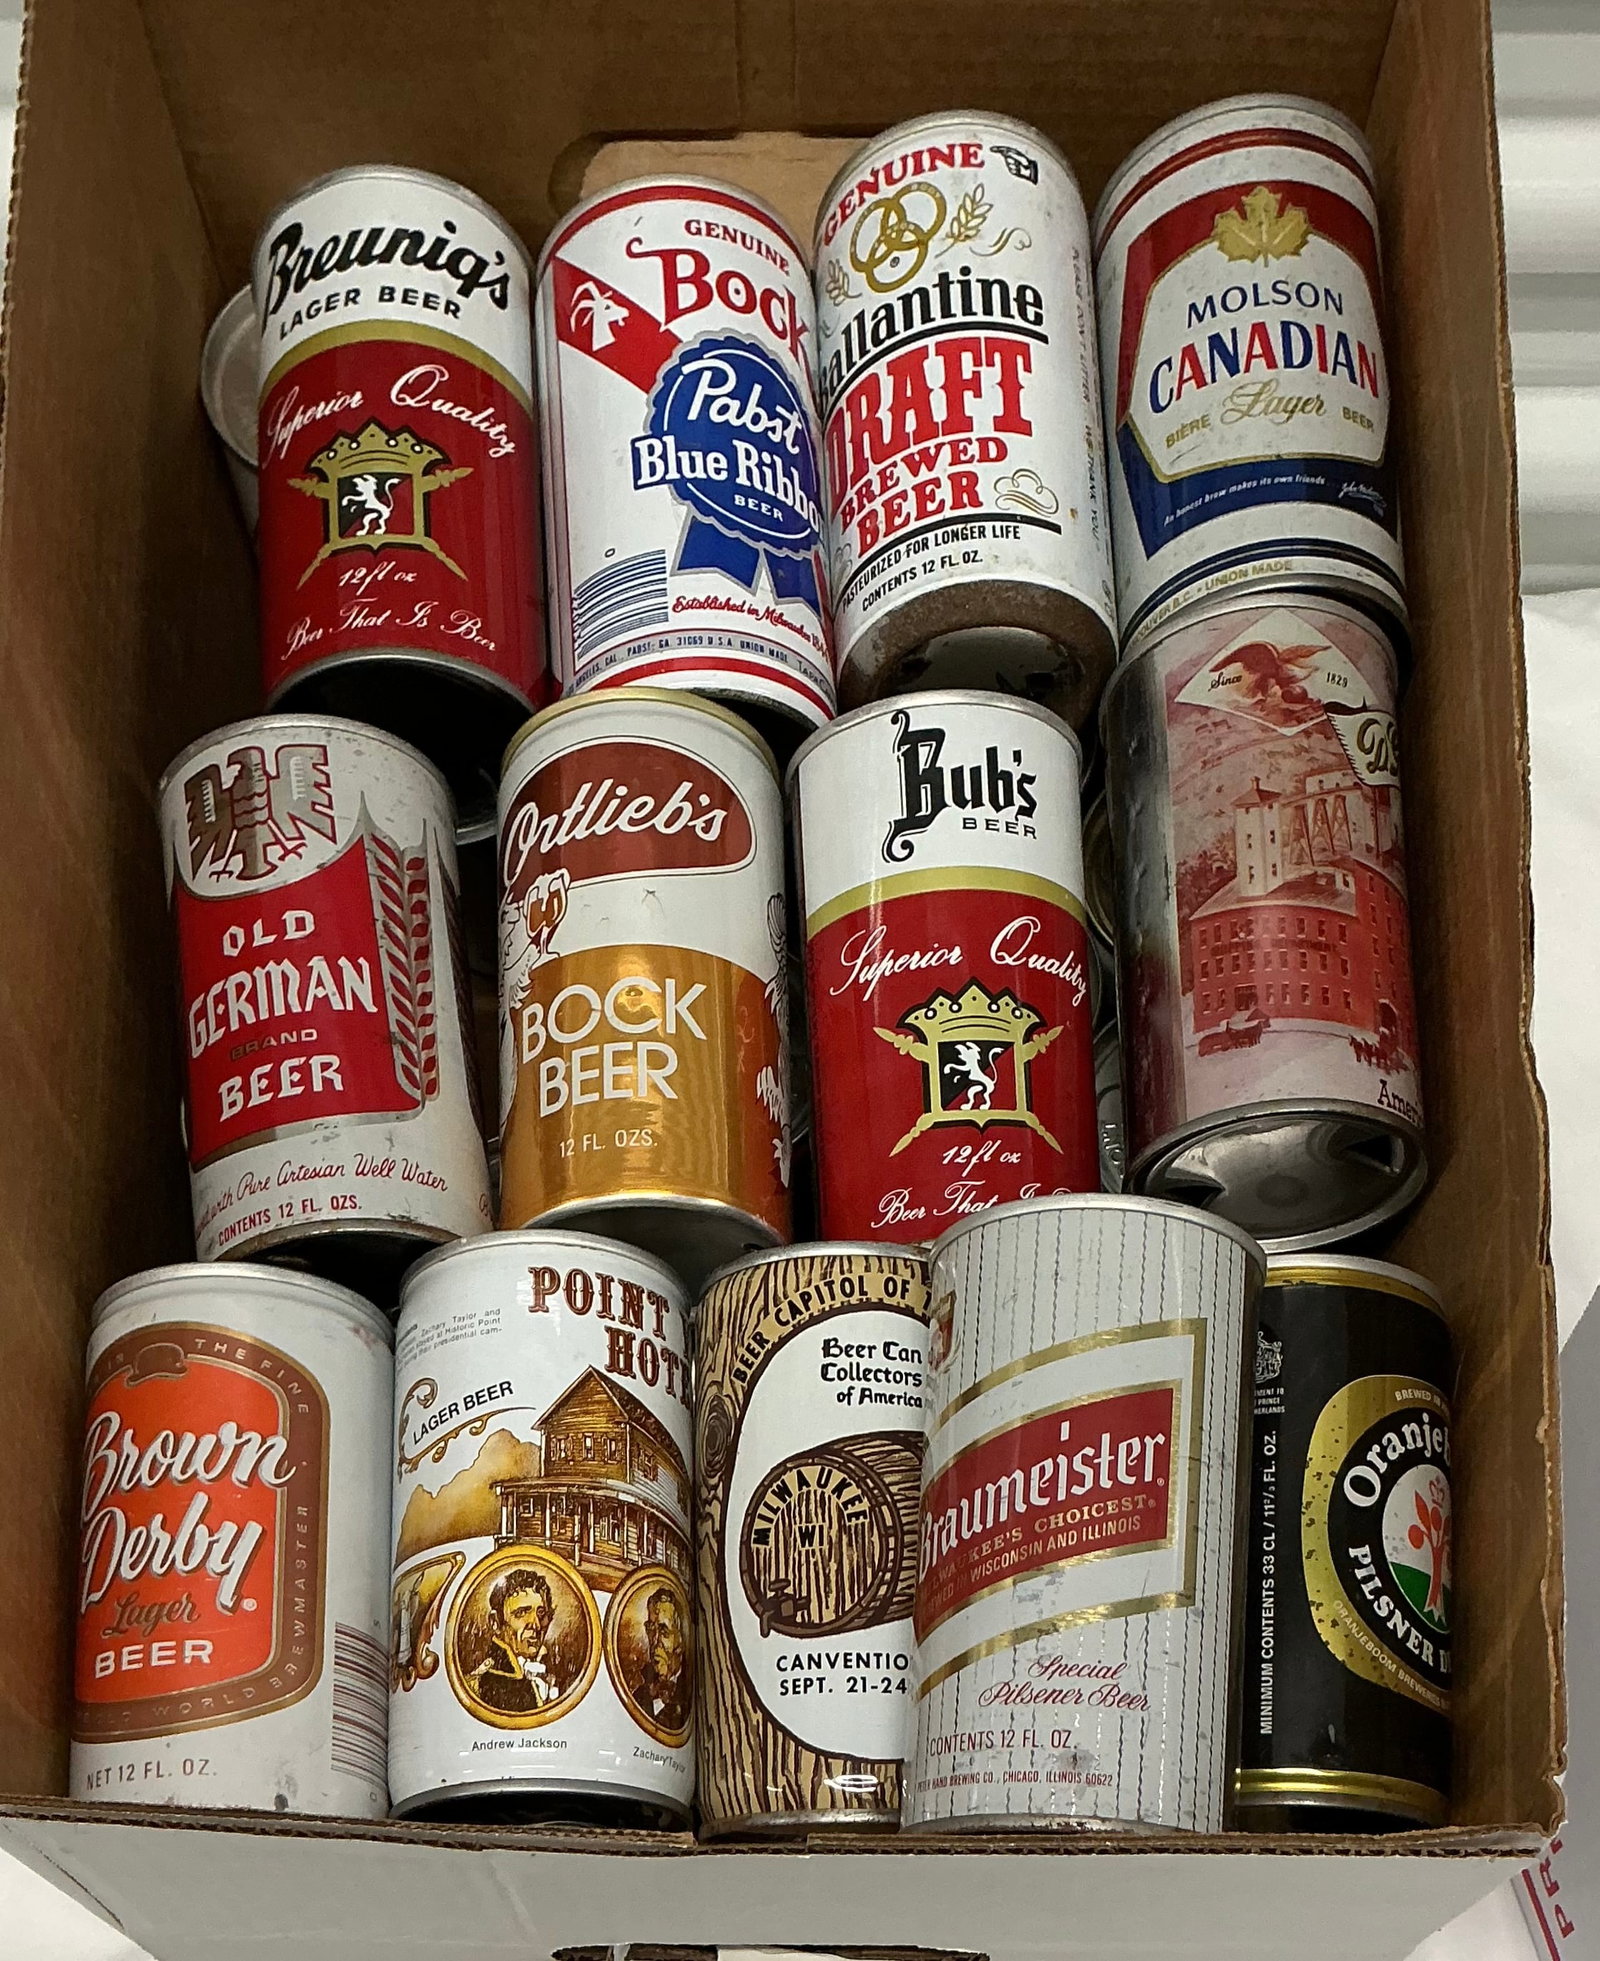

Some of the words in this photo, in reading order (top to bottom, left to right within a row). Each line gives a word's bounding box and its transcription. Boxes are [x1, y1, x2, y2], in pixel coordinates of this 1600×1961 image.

[823, 143, 985, 247] GENUINE
[684, 218, 789, 277] GENUINE
[262, 220, 511, 338] Breunig's
[1186, 280, 1344, 328] MOLSON
[279, 286, 360, 340] LAGER
[379, 286, 461, 320] BEER
[625, 237, 818, 385] BOCK
[1149, 320, 1379, 414] CANADIAN
[262, 385, 364, 468] Superior
[390, 364, 516, 459] Quality
[682, 359, 801, 454] Pabst
[824, 336, 1032, 522] DRAFT
[1220, 378, 1327, 425] Lager
[1342, 406, 1374, 433] BEER
[637, 435, 728, 487] Blue
[841, 437, 1008, 535] BREWED
[735, 495, 783, 522] BEER
[1229, 480, 1258, 493] makes
[857, 470, 984, 559] BEER
[842, 549, 902, 613] PASTEURIZED
[906, 536, 930, 559] FOR
[934, 524, 987, 548] LONGER
[992, 525, 1020, 541] LIFE
[862, 570, 917, 612] CONTENTS
[922, 563, 936, 575] 12
[962, 550, 984, 564] OZ.
[1205, 569, 1249, 591] UNION
[1252, 561, 1293, 577] MADE
[281, 616, 324, 660] Beer
[330, 597, 391, 633] That
[396, 600, 438, 628] Is
[440, 609, 497, 651] Beer
[672, 595, 746, 613] Established
[747, 604, 760, 616] in
[740, 640, 764, 653] UNION
[1208, 672, 1242, 691] Since
[1326, 672, 1348, 688] 1829
[882, 710, 1038, 864] Bub's
[504, 778, 727, 887] Ortlieb's
[961, 817, 1038, 839] BEER
[223, 909, 315, 958] OLD
[830, 925, 964, 1001] Superior
[989, 916, 1087, 1006] Quality
[188, 955, 378, 1059] GERMAN
[522, 976, 707, 1064] BOCK
[229, 1028, 318, 1060] BRAND
[218, 1054, 344, 1123] BEER
[539, 1041, 679, 1118] BEER
[559, 1138, 575, 1158] 12
[582, 1134, 606, 1153] FL.
[615, 1129, 658, 1149] OZS.
[237, 1171, 271, 1200] Pure
[277, 1160, 345, 1187] Artesian
[353, 1153, 396, 1179] Well
[401, 1158, 448, 1191] Water
[218, 1208, 271, 1246] CONTENTS
[278, 1203, 294, 1219] 12
[301, 1198, 323, 1215] FL.
[330, 1194, 362, 1211] OZS.
[871, 1187, 926, 1229] Beer
[933, 1180, 999, 1216] That
[478, 1317, 501, 1326] Point
[484, 1308, 501, 1317] and
[528, 1266, 669, 1341] POINT
[195, 1338, 246, 1361] THE
[732, 1330, 771, 1385] BEER
[774, 1275, 868, 1328] CAPITOL
[884, 1276, 910, 1300] OF
[821, 1337, 877, 1359] Beer
[882, 1341, 923, 1364] Can
[820, 1362, 923, 1387] Collectors
[836, 1386, 854, 1406] of
[858, 1387, 923, 1408] America
[1394, 1388, 1432, 1401] BREWED
[413, 1402, 460, 1445] LAGER
[463, 1381, 514, 1411] BEER
[81, 1410, 296, 1520] Brown
[1264, 1430, 1277, 1457] OZ.
[1263, 1461, 1276, 1482] FL.
[752, 1466, 869, 1547] MILWAUKEE
[919, 1420, 1165, 1584] Braumeister
[1034, 1493, 1147, 1533] CHOICEST
[80, 1490, 263, 1616] Derby
[799, 1525, 825, 1547] WI
[970, 1540, 1043, 1582] WISCONSIN
[1046, 1530, 1078, 1552] AND
[1082, 1514, 1141, 1542] ILLINOIS
[1263, 1532, 1275, 1551] CL
[1262, 1555, 1275, 1575] 33
[102, 1592, 200, 1639] Lager
[1261, 1578, 1275, 1659] CONTENTS
[1348, 1544, 1434, 1666] PILSNER
[95, 1639, 214, 1679] BEER
[1333, 1600, 1397, 1673] ORANJEBOOM
[779, 1677, 833, 1696] SEPT.
[1028, 1654, 1129, 1680] Special
[152, 1686, 256, 1717] WORLD
[978, 1681, 1084, 1709] Pilsener
[1087, 1683, 1152, 1712] Beer
[1260, 1663, 1273, 1734] MINIMUM
[472, 1738, 515, 1752] Andrew
[518, 1738, 567, 1748] Jackson
[930, 1730, 994, 1757] CONTENTS
[1000, 1730, 1015, 1748] 12
[1023, 1730, 1044, 1748] FL.
[1051, 1730, 1077, 1749] OZ.
[86, 1767, 112, 1790] NET
[118, 1763, 135, 1782] 12
[144, 1760, 173, 1779] FL.
[183, 1758, 218, 1776] OZ.
[950, 1772, 980, 1786] BREWING
[1003, 1771, 1041, 1785] CHICAGO,
[1046, 1771, 1082, 1784] ILLINOIS
[1085, 1773, 1113, 1787] 60622
